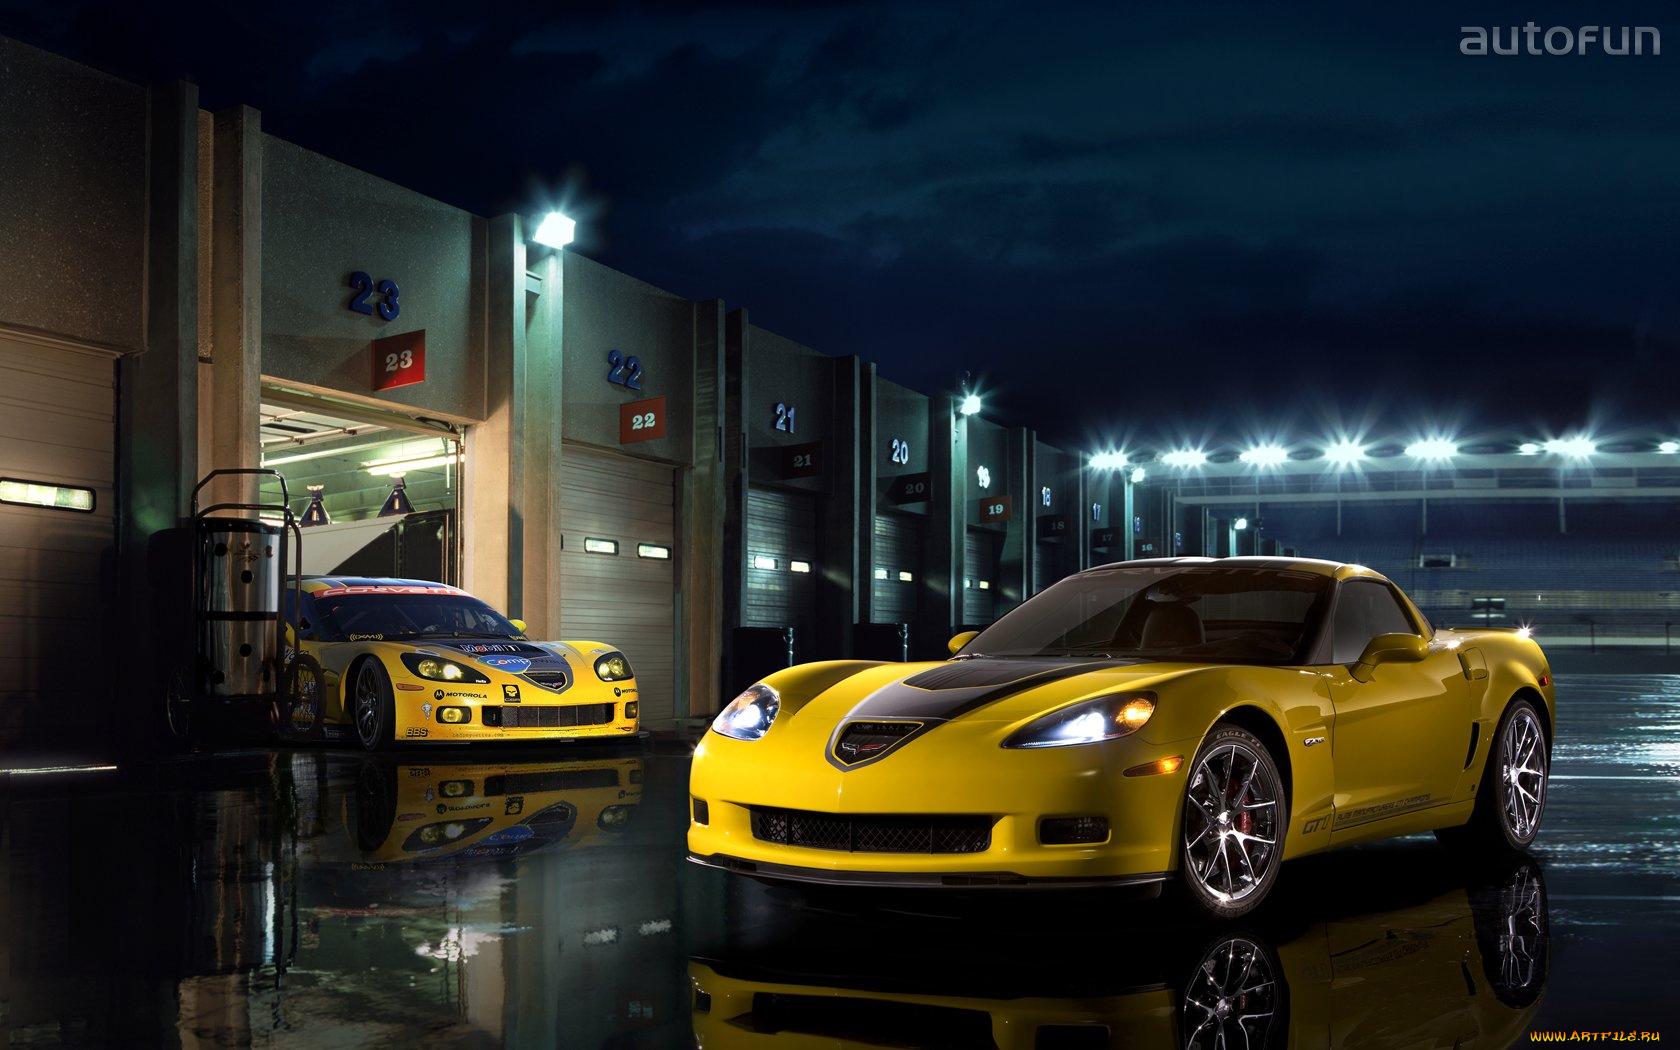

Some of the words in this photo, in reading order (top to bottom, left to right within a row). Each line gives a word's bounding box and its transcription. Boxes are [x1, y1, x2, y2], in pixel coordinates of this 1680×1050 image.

[349, 270, 400, 321] 23
[385, 349, 413, 373] 23
[607, 349, 642, 390] 22
[632, 412, 656, 431] 22
[775, 403, 795, 434] 21
[793, 453, 812, 468] 21
[892, 438, 909, 465] 20
[905, 482, 925, 495] 20
[1041, 486, 1051, 507] 18
[988, 503, 1004, 515] 19
[406, 728, 429, 738] BBS
[1216, 730, 1247, 739] EAGLE
[1302, 813, 1331, 835] GT1
